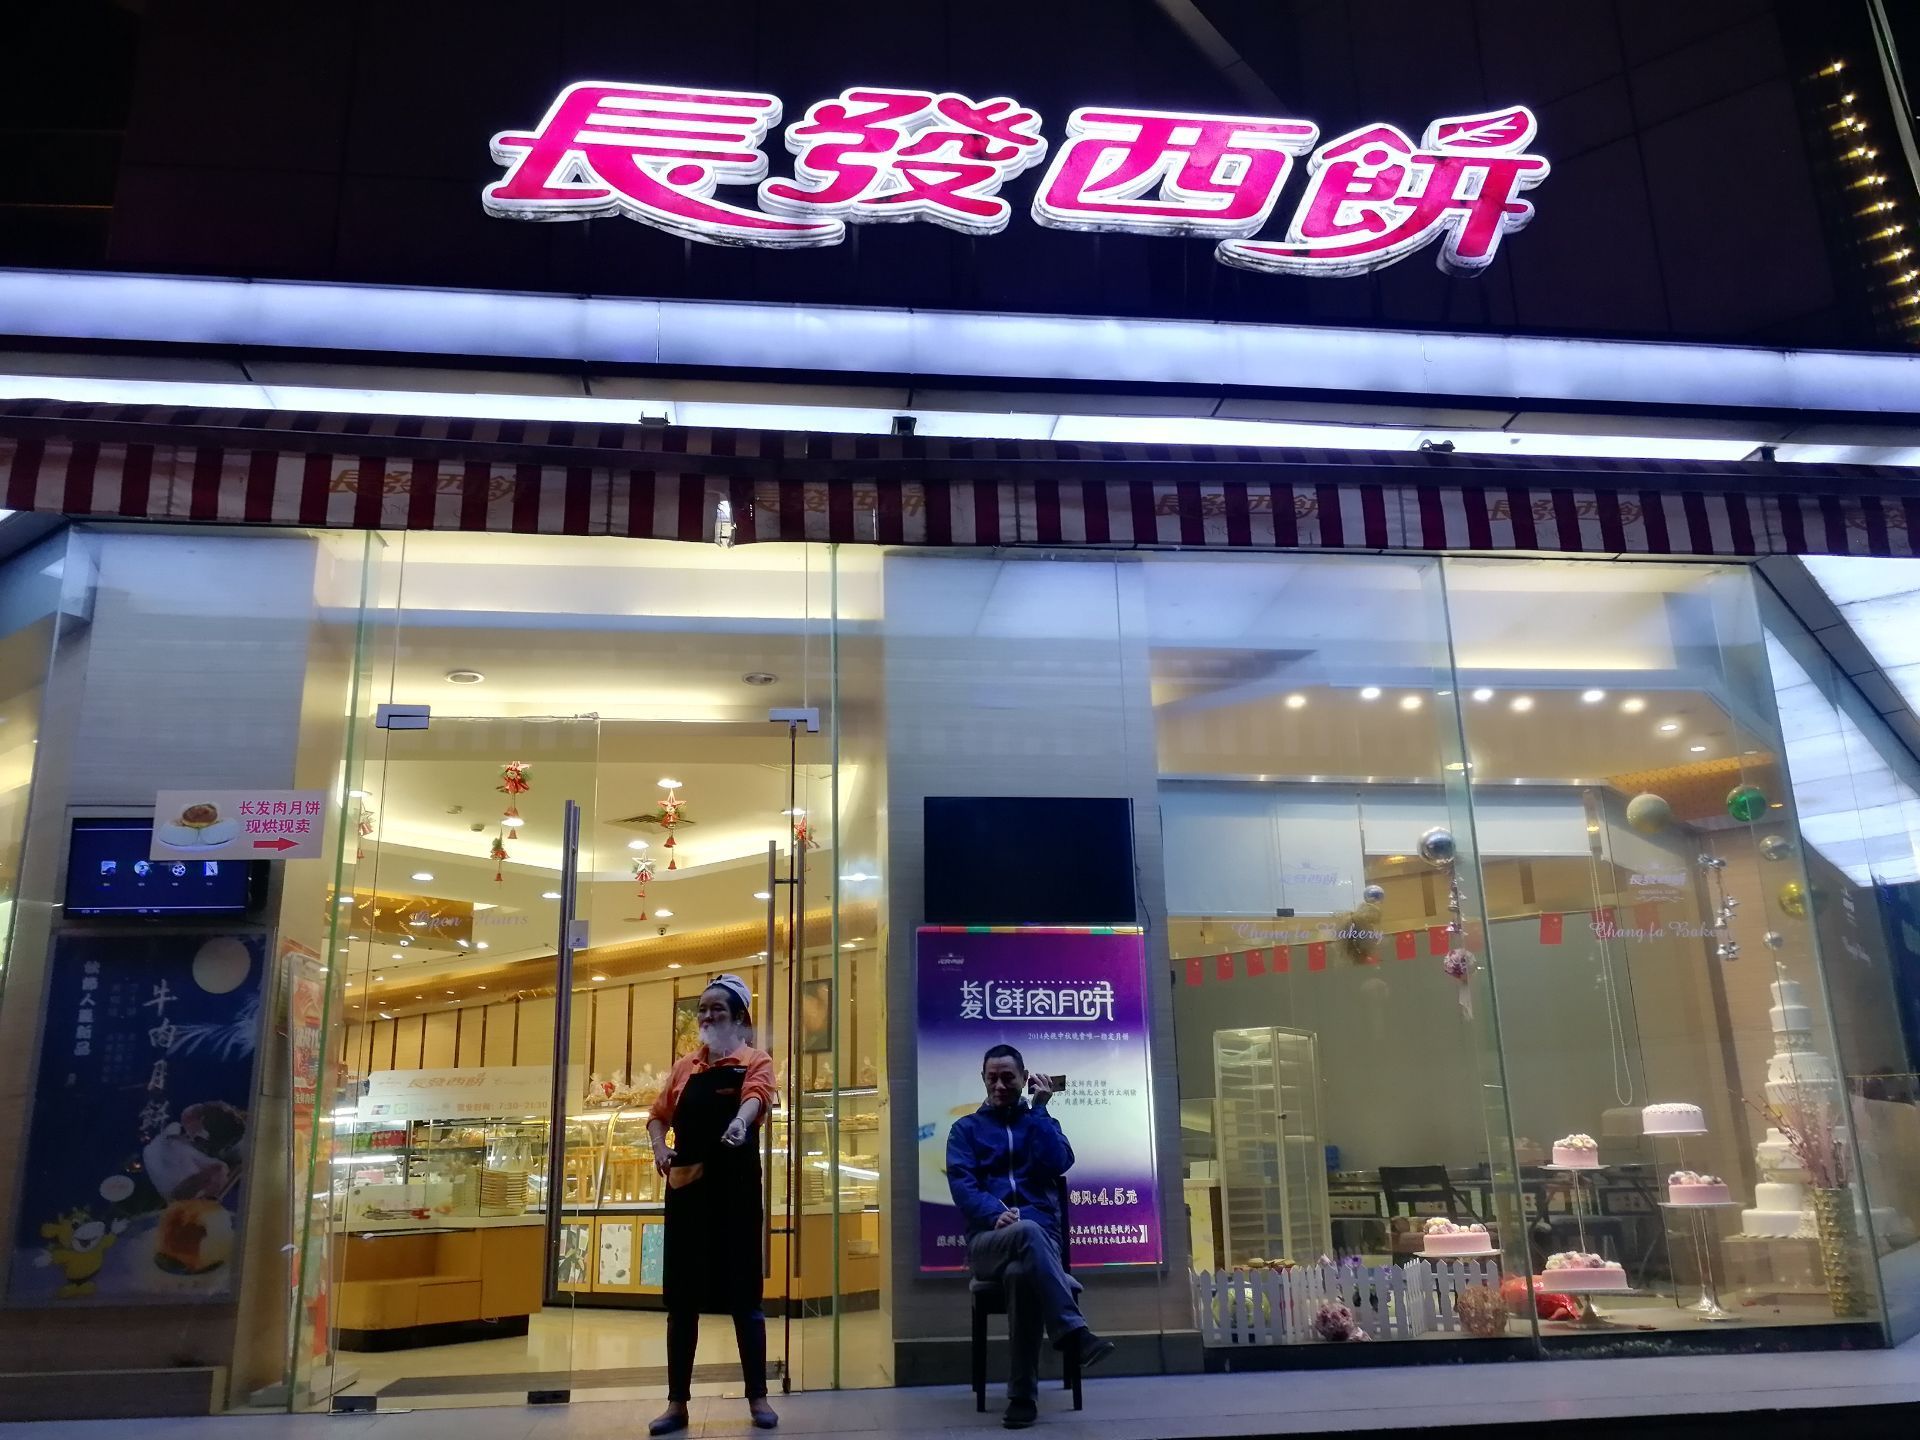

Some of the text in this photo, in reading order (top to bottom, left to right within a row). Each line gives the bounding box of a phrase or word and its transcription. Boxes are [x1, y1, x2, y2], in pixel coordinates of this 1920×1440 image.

[483, 79, 1552, 278] 長發西餅
[239, 800, 321, 816] 长发肉月饼
[246, 819, 311, 834] 现烘现卖
